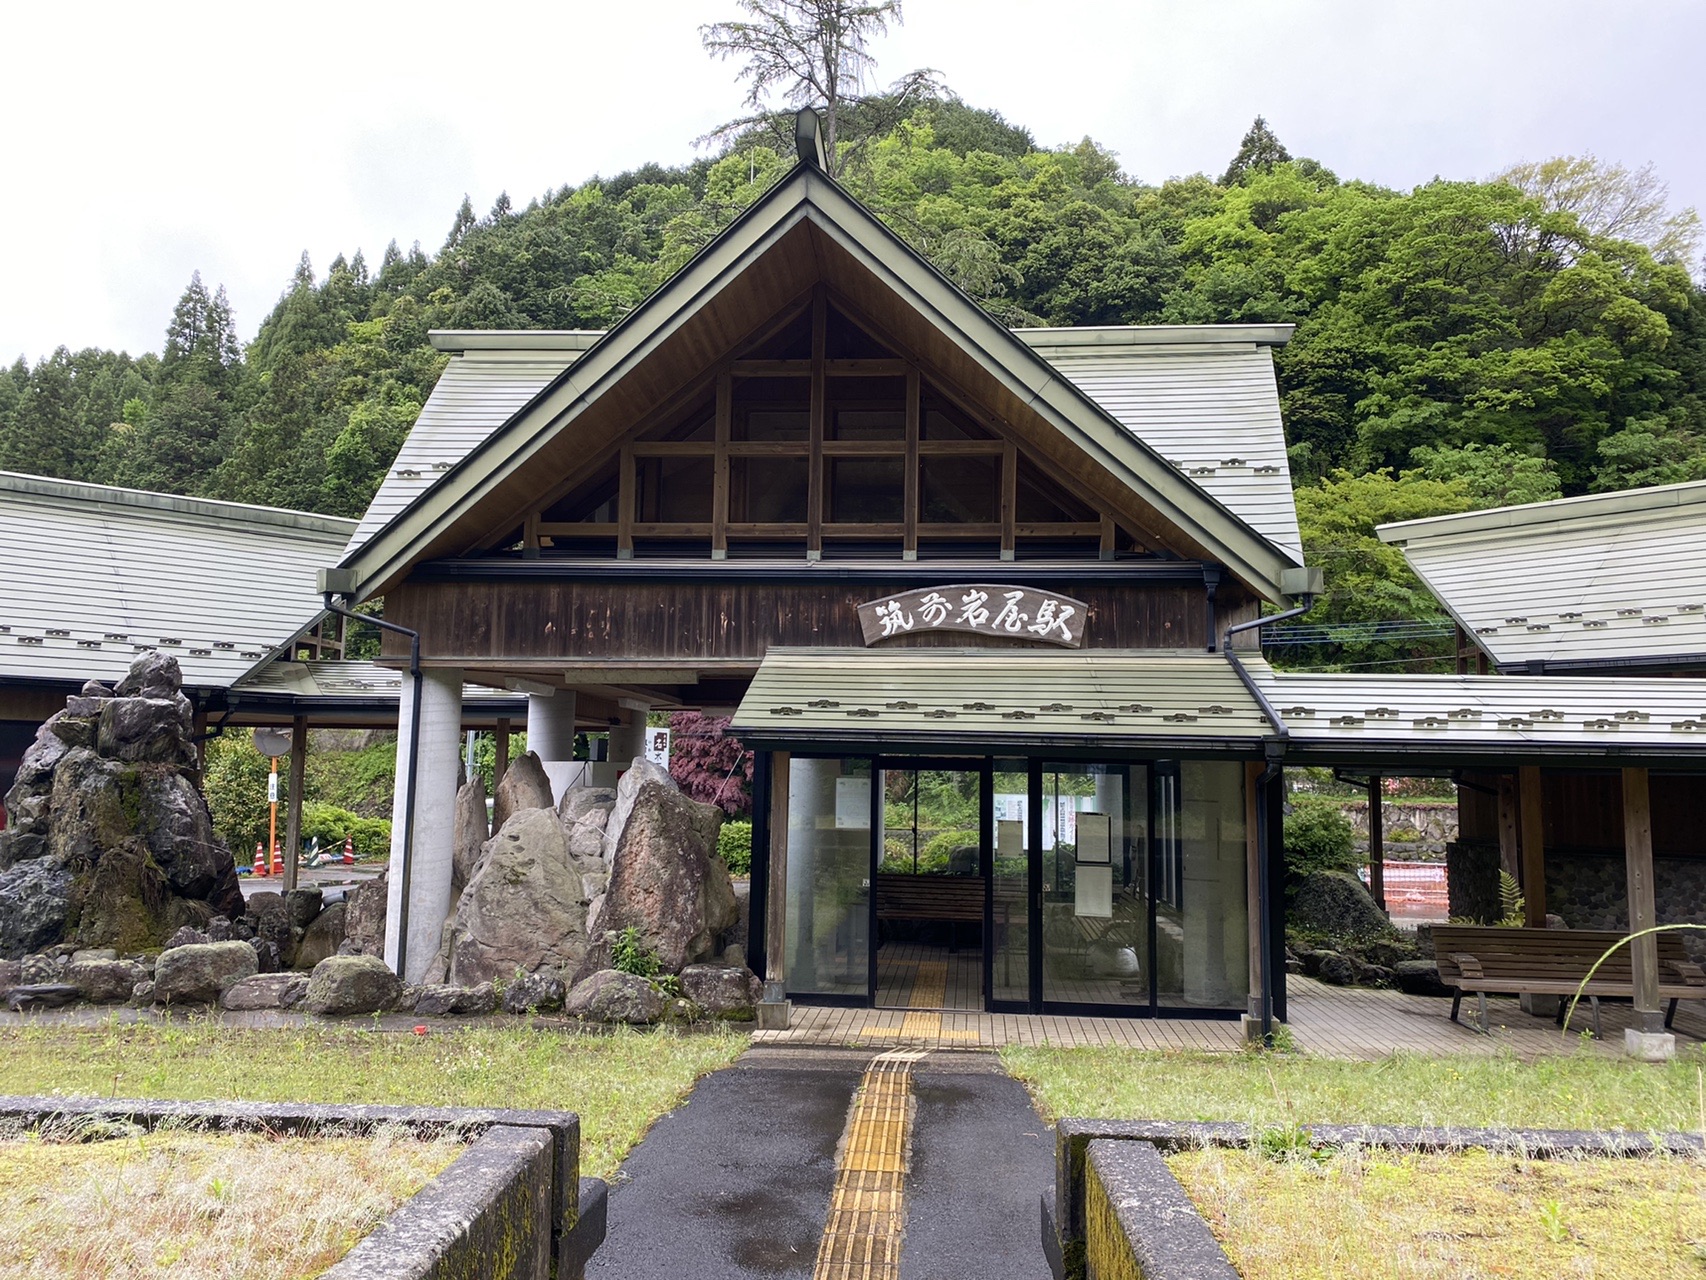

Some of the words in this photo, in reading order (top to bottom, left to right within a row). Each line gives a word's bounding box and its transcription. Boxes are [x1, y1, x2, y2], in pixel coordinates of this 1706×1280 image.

[875, 589, 1075, 641] 筑前岩屋駅
